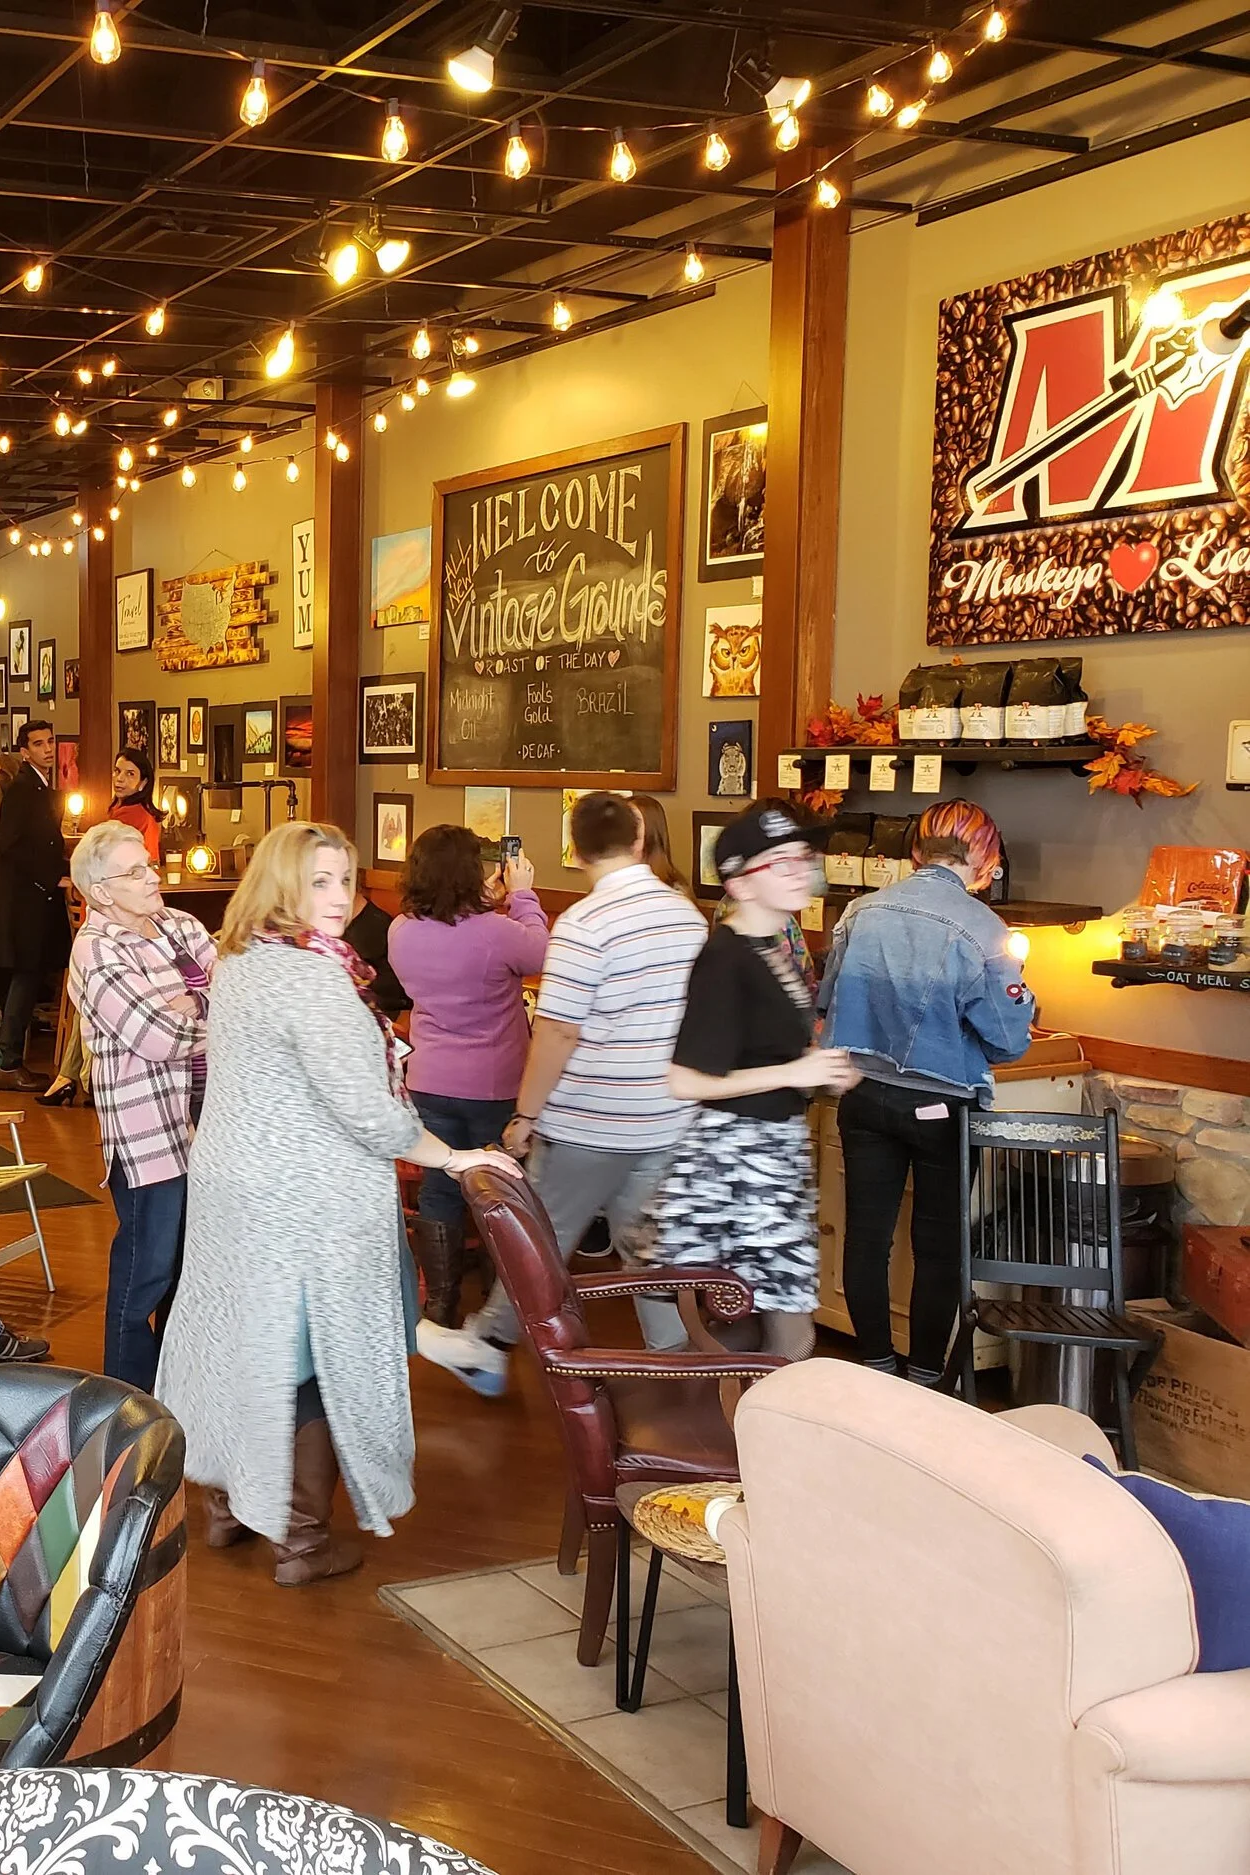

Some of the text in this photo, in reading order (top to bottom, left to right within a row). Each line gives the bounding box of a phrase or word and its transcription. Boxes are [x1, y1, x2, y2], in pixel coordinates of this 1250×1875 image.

[471, 465, 642, 576] WELCOME
[524, 539, 571, 573] to
[944, 528, 1250, 610] Muskego Loc
[298, 533, 311, 634] YUM
[560, 530, 667, 652] Grounds
[486, 651, 606, 677] ROAST OF THE DAY
[527, 681, 553, 704] Fool's
[524, 706, 553, 724] Gold
[1167, 971, 1250, 988] OAT MEAL S
